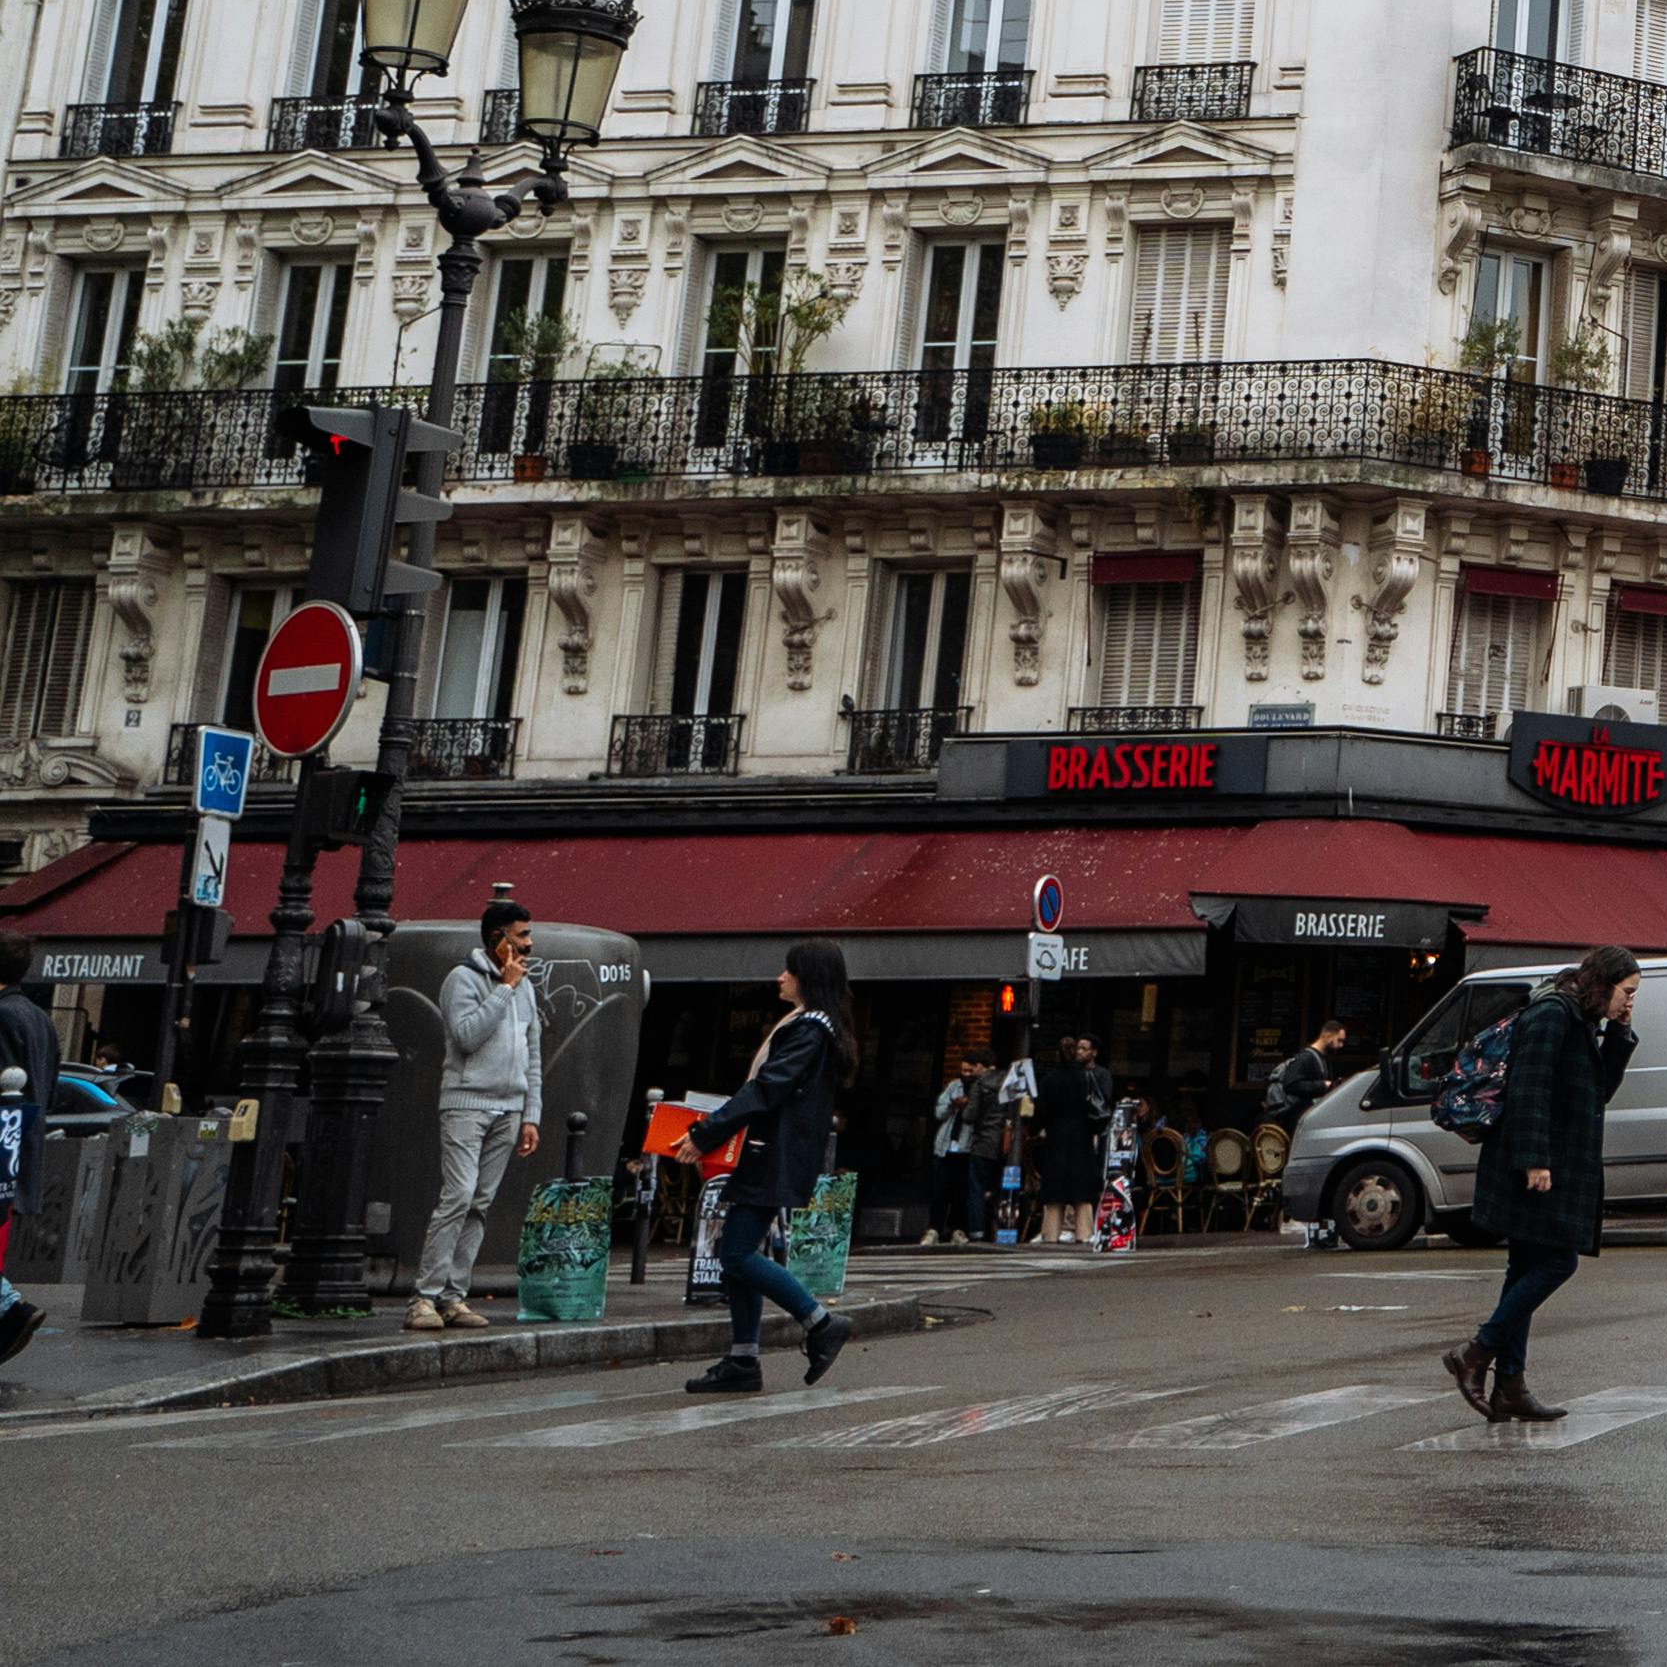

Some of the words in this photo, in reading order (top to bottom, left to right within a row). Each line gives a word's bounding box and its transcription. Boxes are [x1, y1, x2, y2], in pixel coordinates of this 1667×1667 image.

[128, 710, 139, 726] 2
[1592, 725, 1611, 745] LA
[1048, 743, 1217, 791] BRASSERIE
[1532, 743, 1665, 807] MARMITE
[1294, 912, 1386, 939] BRASSERIE
[42, 954, 145, 979] RESTAURANT
[1061, 947, 1089, 972] AFE
